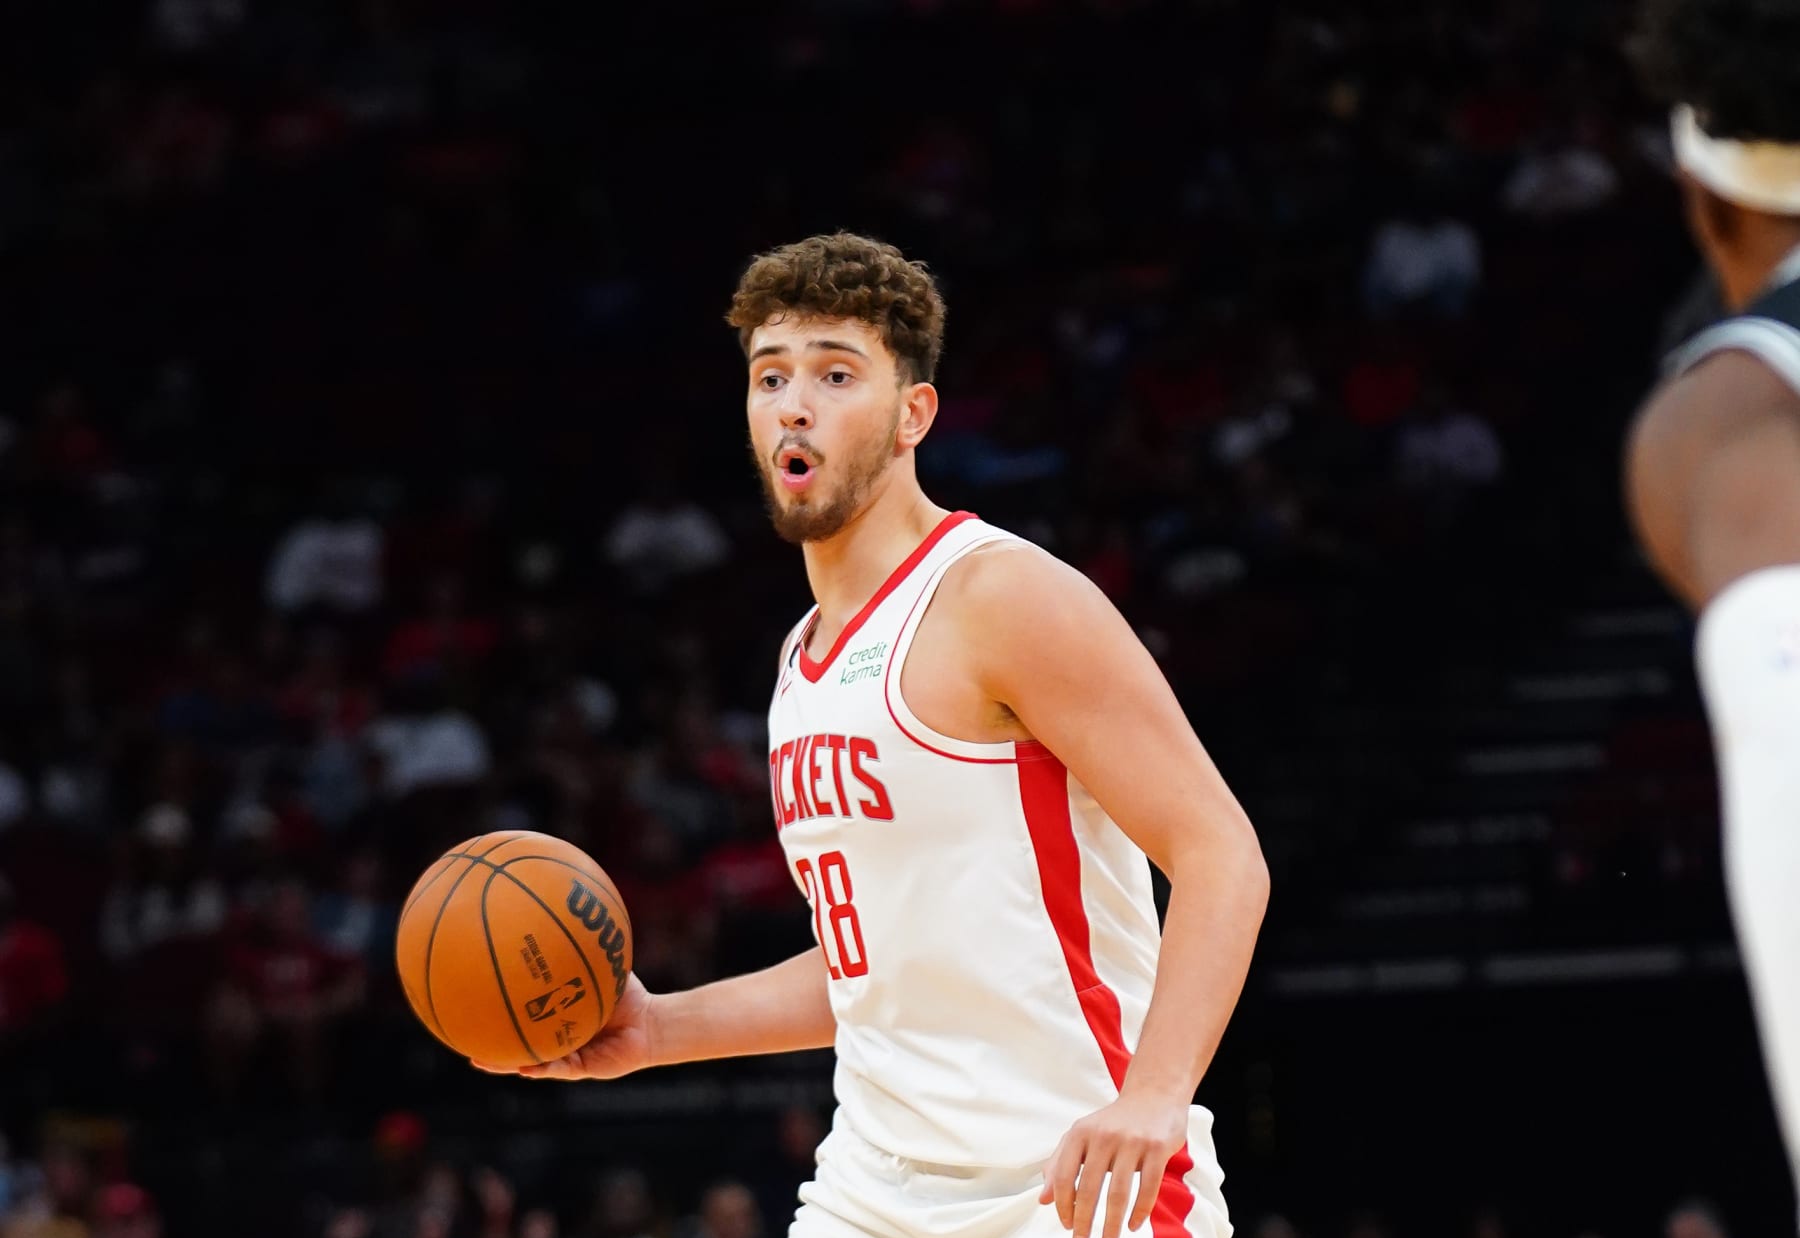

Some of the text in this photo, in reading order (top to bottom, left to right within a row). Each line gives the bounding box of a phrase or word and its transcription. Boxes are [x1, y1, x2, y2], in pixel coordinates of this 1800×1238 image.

[849, 641, 887, 665] credit
[840, 664, 882, 686] karma
[769, 733, 895, 833] OCKETS
